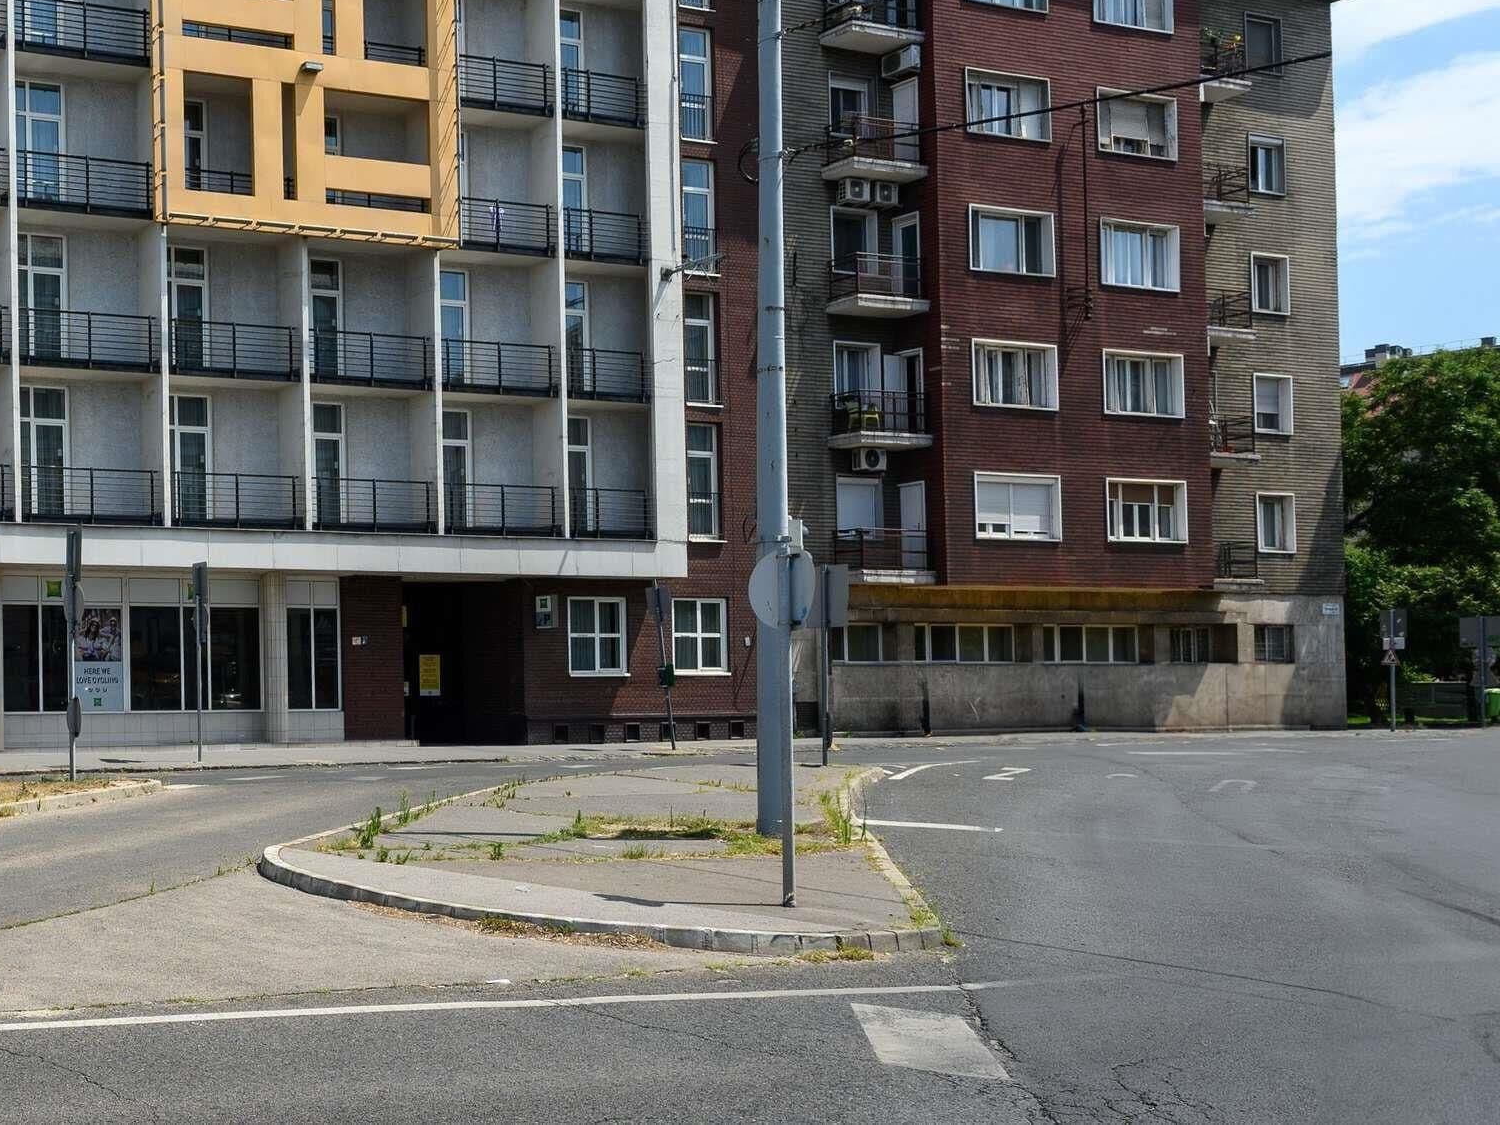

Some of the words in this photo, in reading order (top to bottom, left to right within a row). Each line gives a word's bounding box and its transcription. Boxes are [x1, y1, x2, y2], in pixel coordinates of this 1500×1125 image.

[83, 667, 100, 675] HERE
[101, 667, 111, 675] WE
[76, 676, 92, 684] LOVE
[93, 676, 119, 684] CYCLING
